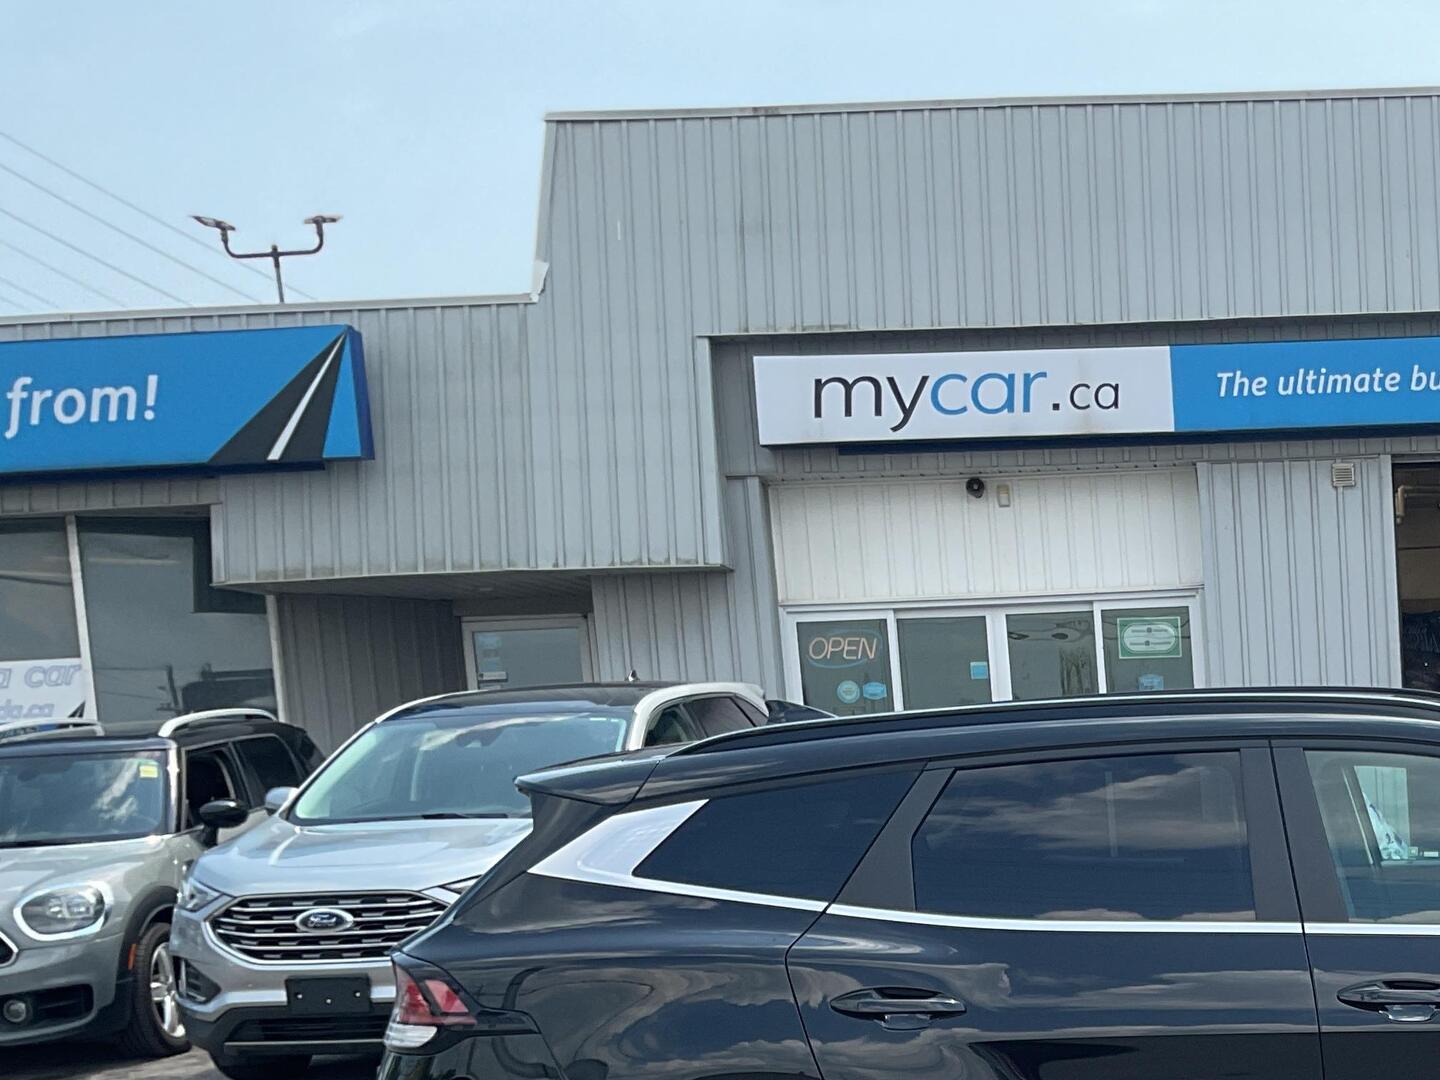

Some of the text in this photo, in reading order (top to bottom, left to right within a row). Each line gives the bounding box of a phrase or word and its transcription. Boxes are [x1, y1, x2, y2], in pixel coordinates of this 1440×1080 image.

[1216, 370, 1267, 397] The
[1278, 368, 1400, 395] ultimate
[4, 374, 158, 439] from!
[813, 371, 1120, 433] mycar.ca
[808, 637, 877, 660] OPEN
[24, 664, 81, 688] car
